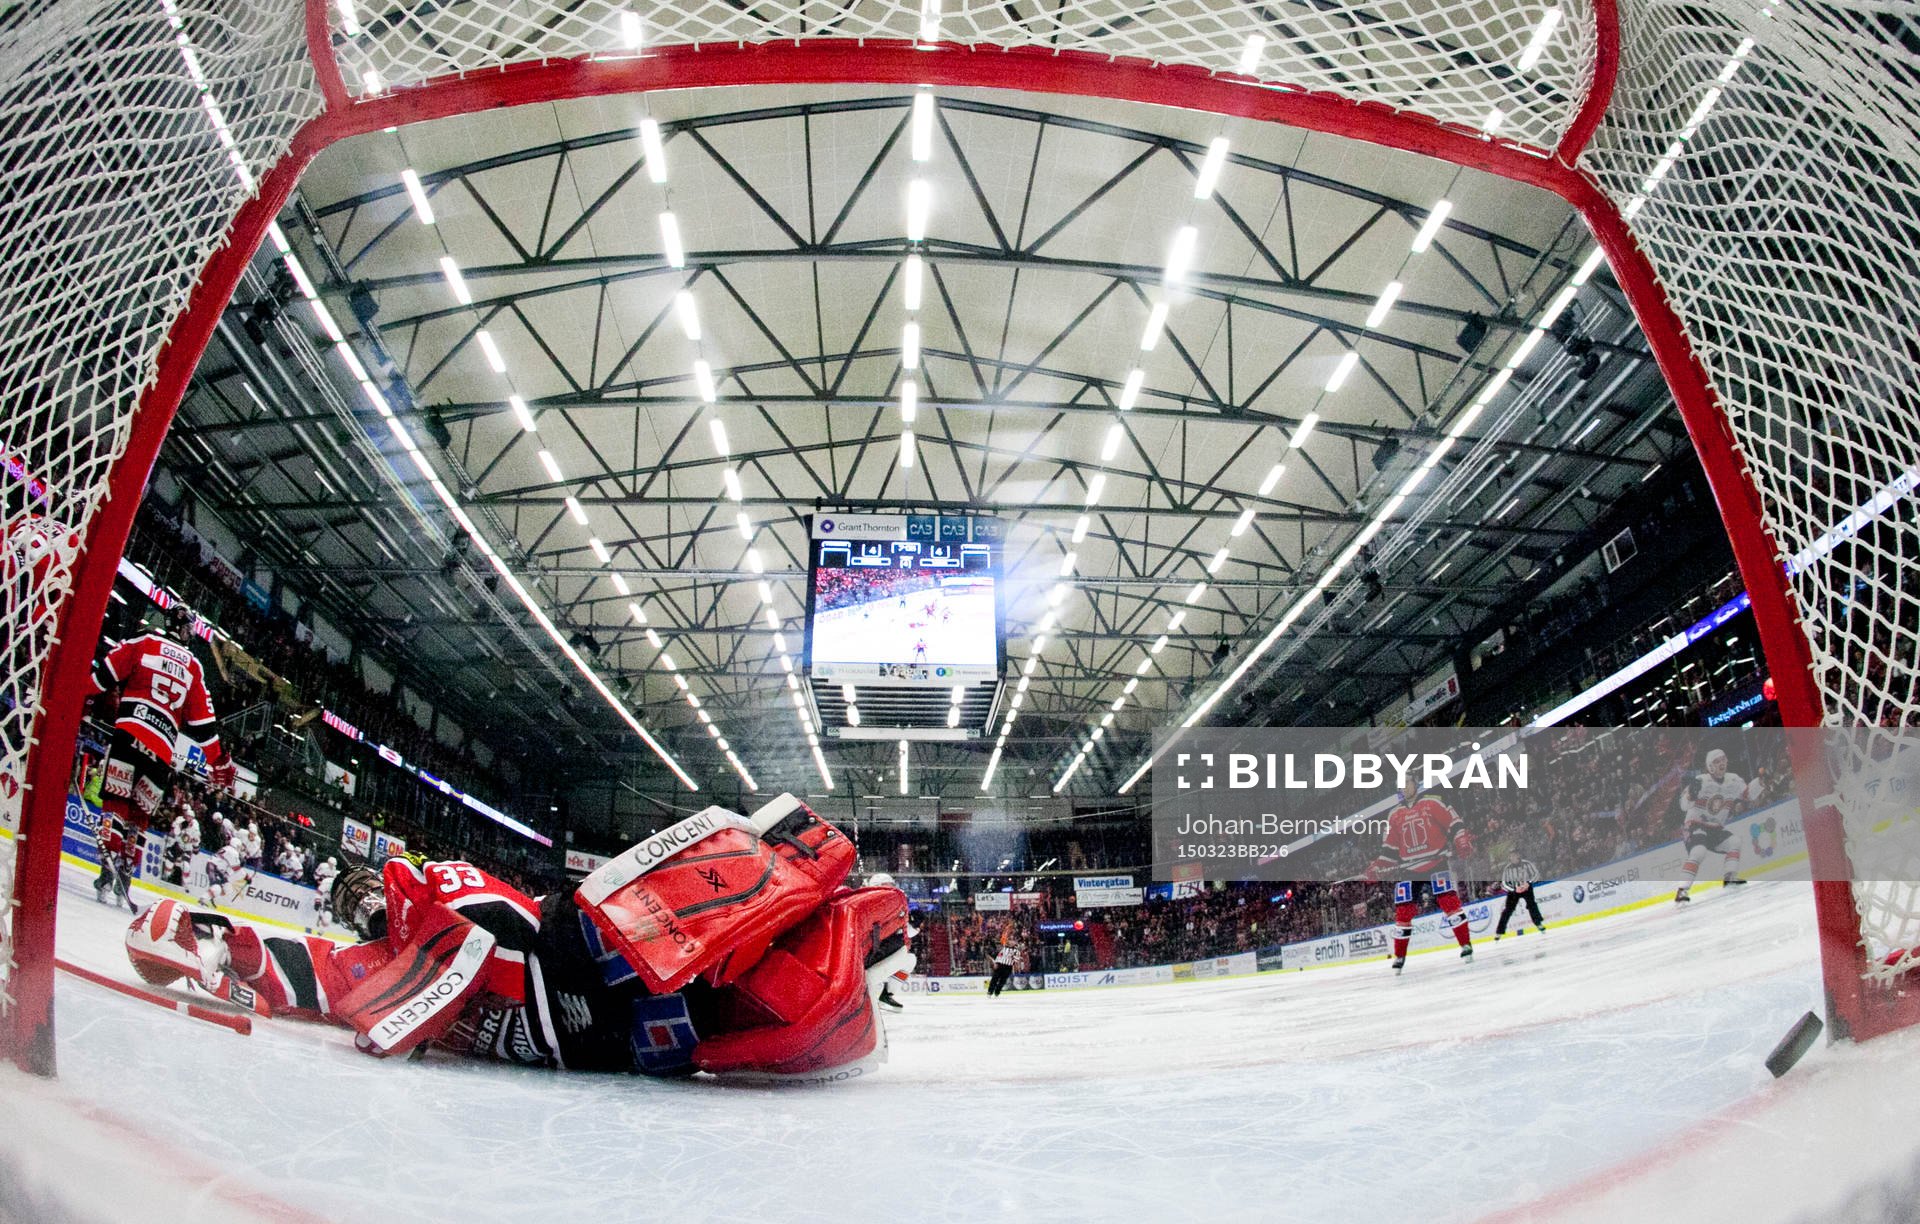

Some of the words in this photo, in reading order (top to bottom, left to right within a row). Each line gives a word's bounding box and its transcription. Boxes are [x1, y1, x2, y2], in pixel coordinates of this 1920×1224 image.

[838, 522, 863, 532] Grant
[863, 522, 900, 532] Thornton
[151, 673, 187, 711] 57
[346, 825, 368, 844] ELON
[634, 812, 716, 866] CONCENT
[377, 836, 404, 857] ELON
[433, 865, 486, 894] 33
[1078, 878, 1130, 888] Vintergatan
[1587, 874, 1626, 894] Carlsson
[246, 886, 300, 910] EASTON
[632, 888, 697, 954] CONCENT
[901, 981, 940, 992] OBAB
[1047, 974, 1089, 985] HOIST
[382, 971, 464, 1041] CONCENT
